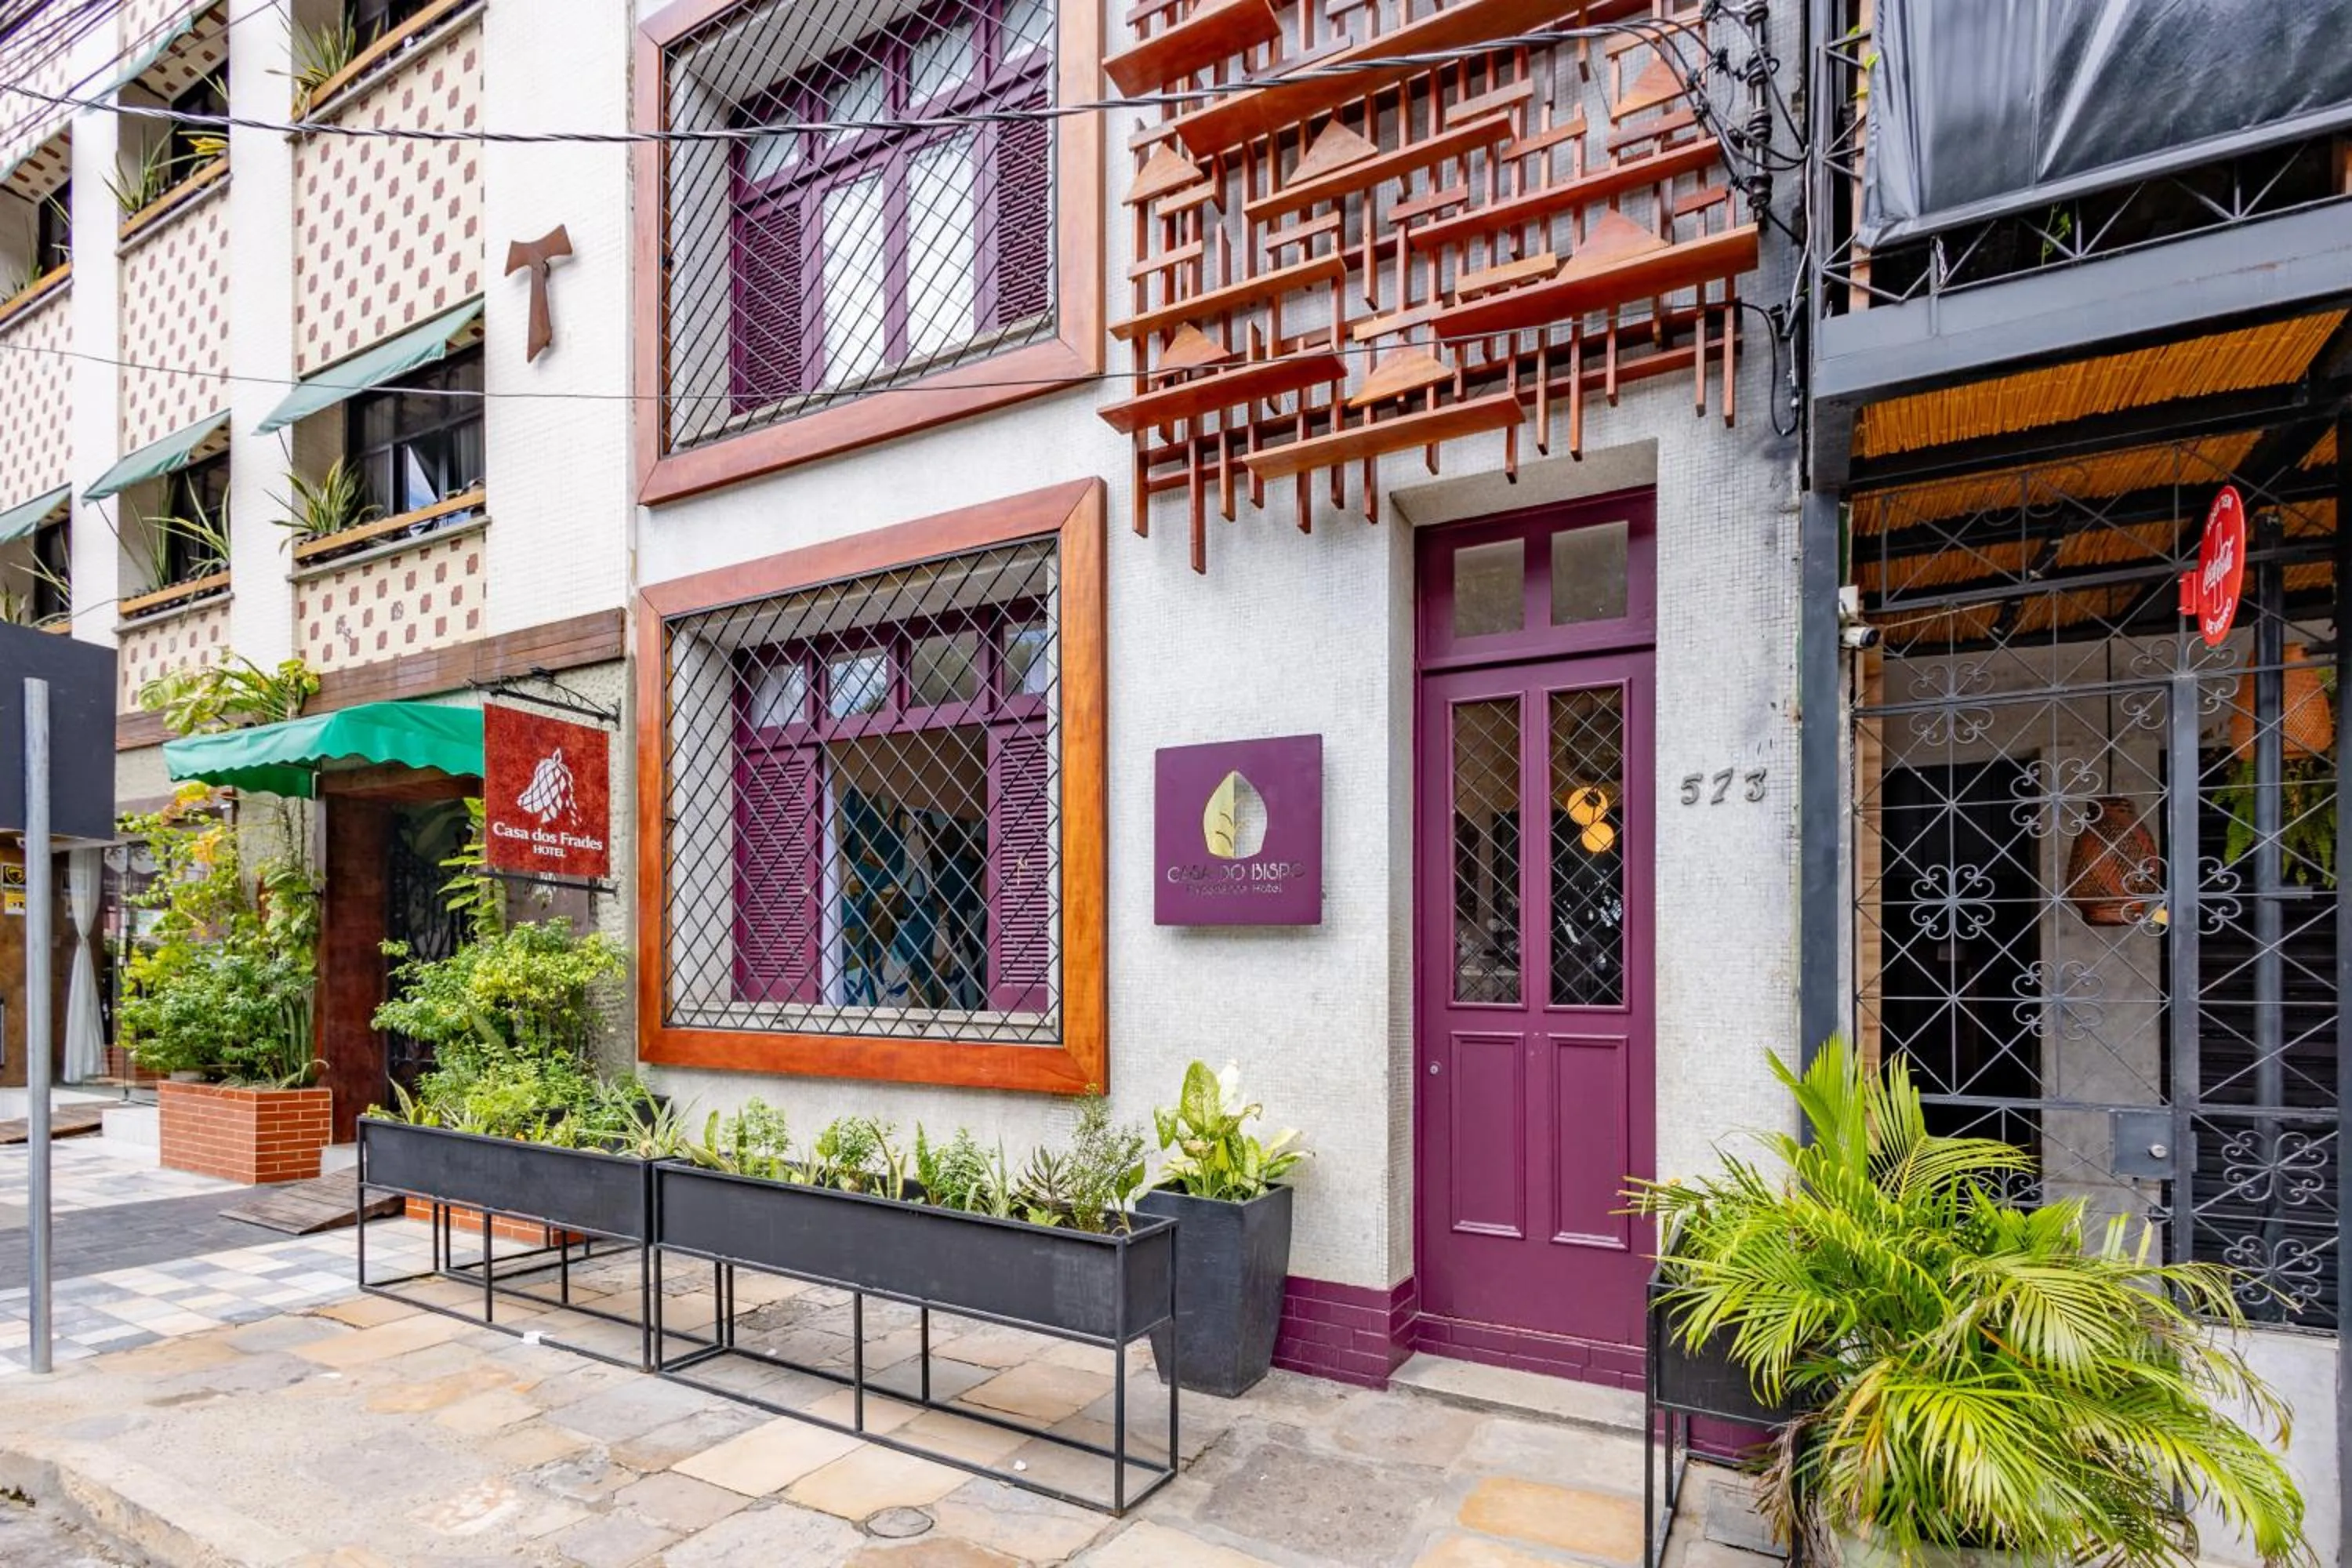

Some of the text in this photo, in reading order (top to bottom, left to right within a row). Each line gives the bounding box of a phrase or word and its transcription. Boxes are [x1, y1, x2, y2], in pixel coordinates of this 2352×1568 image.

[1680, 767, 1766, 806] 573
[492, 822, 603, 851] Casa dos Frades
[533, 844, 567, 858] HOTEL
[1167, 861, 1305, 884] CASA DO BISPO
[1252, 882, 1283, 894] Hotel
